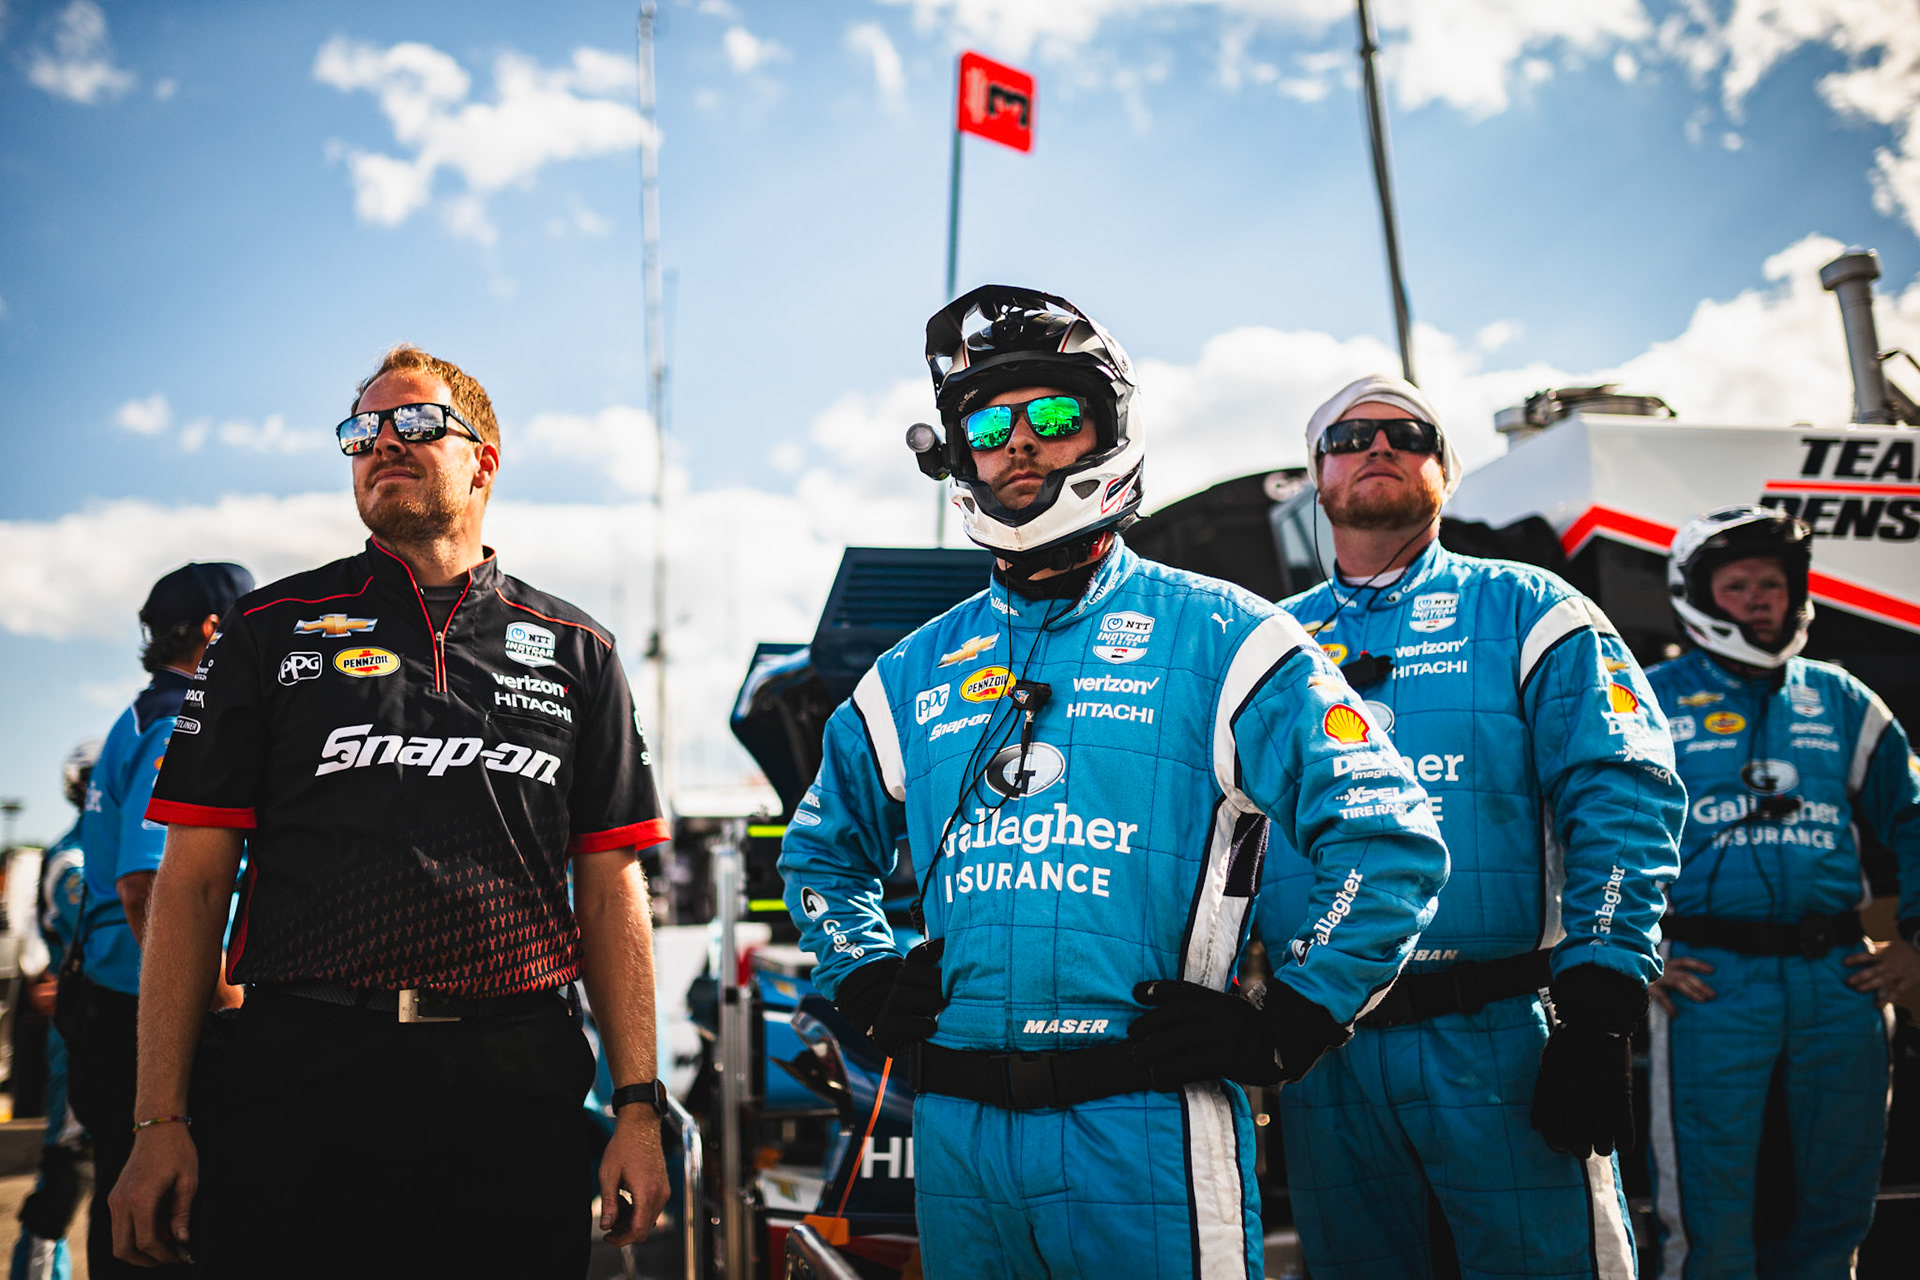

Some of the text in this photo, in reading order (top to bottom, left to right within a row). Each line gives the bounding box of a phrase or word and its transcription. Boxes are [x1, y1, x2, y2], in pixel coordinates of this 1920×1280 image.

[1800, 438, 1920, 481] TEA
[1125, 620, 1151, 630] NTT
[529, 634, 551, 645] NTT
[1096, 631, 1151, 644] INDYCAR
[1394, 640, 1461, 659] verizon
[343, 655, 389, 669] PENNZOIL
[1392, 660, 1468, 681] HITACHI
[492, 671, 566, 698] verizon
[966, 674, 1010, 696] PENNZOIL
[1073, 674, 1148, 695] verizon
[494, 691, 573, 724] HITACHI
[1066, 703, 1155, 725] HITACHI
[929, 713, 994, 742] Snap-on
[315, 723, 562, 787] Snap-on
[1339, 805, 1375, 820] TIRE
[944, 860, 1112, 903] ISURANCE
[1022, 1018, 1109, 1034] MASER
